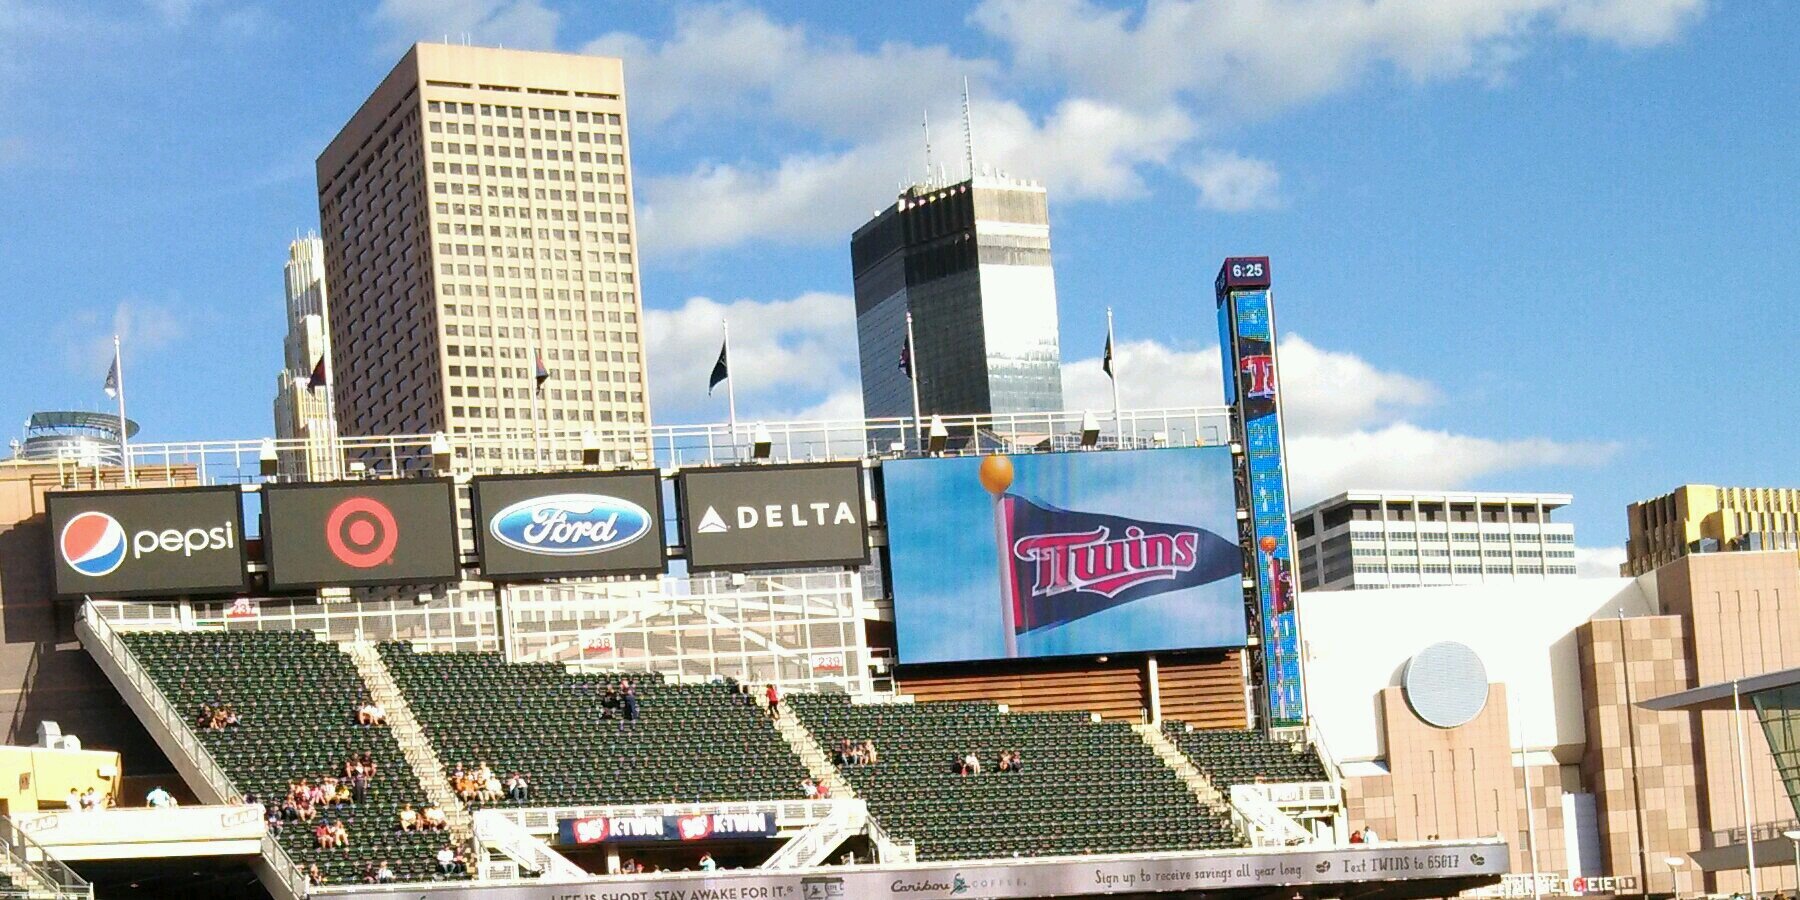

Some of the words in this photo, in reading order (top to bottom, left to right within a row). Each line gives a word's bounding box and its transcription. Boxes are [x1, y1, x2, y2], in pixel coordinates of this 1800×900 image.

[1233, 263, 1263, 277] 6:25
[523, 503, 618, 544] Ford
[737, 502, 857, 529] DELTA
[133, 521, 234, 559] pepsi
[1014, 526, 1199, 598] Twins
[1095, 870, 1119, 888] Sign
[1123, 874, 1136, 886] up
[1140, 868, 1151, 882] to
[1156, 870, 1191, 881] receive
[1194, 867, 1232, 882] savings
[1236, 864, 1250, 877] all
[1254, 867, 1276, 880] year
[1342, 859, 1366, 873] Text
[1370, 856, 1409, 872] TWINS
[1414, 856, 1424, 870] to
[654, 890, 686, 900] STAY
[690, 888, 737, 900] AWAKE
[741, 887, 768, 898] FOR
[891, 880, 950, 892] Caribou
